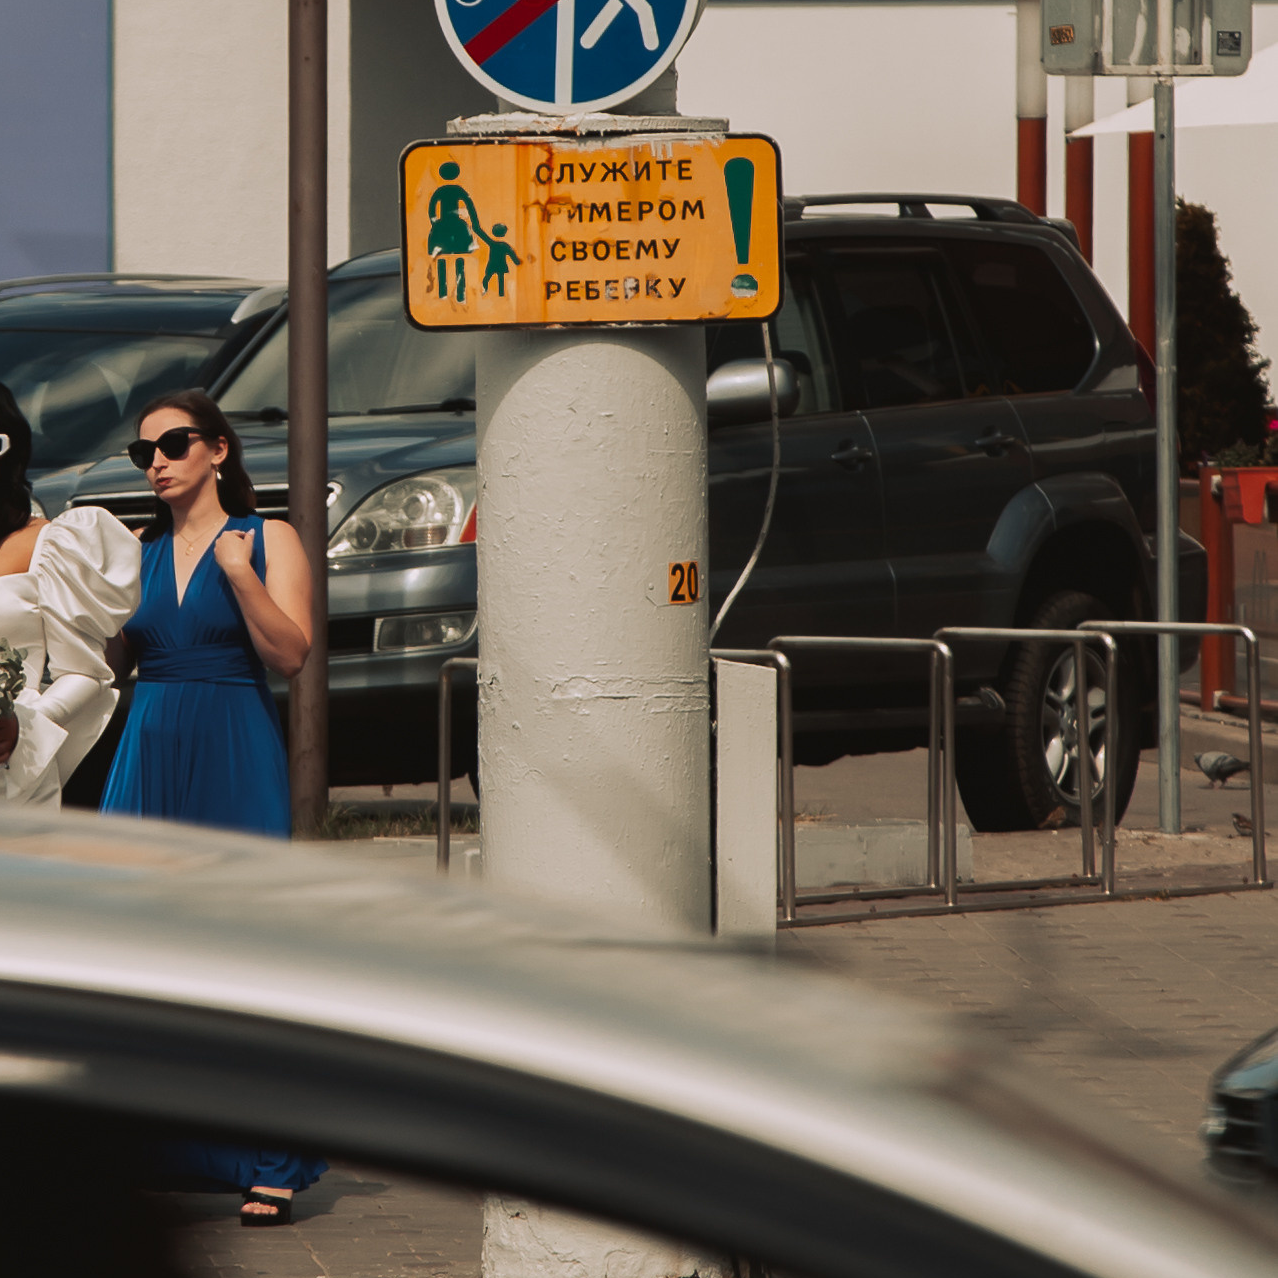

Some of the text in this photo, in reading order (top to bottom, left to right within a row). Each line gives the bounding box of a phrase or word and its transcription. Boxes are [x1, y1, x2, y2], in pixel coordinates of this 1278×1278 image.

[535, 159, 693, 184] СЛУЖИТЕ
[544, 199, 705, 224] РИМЕРОМ
[550, 238, 681, 262] СВОЕМУ
[670, 562, 699, 602] 20
